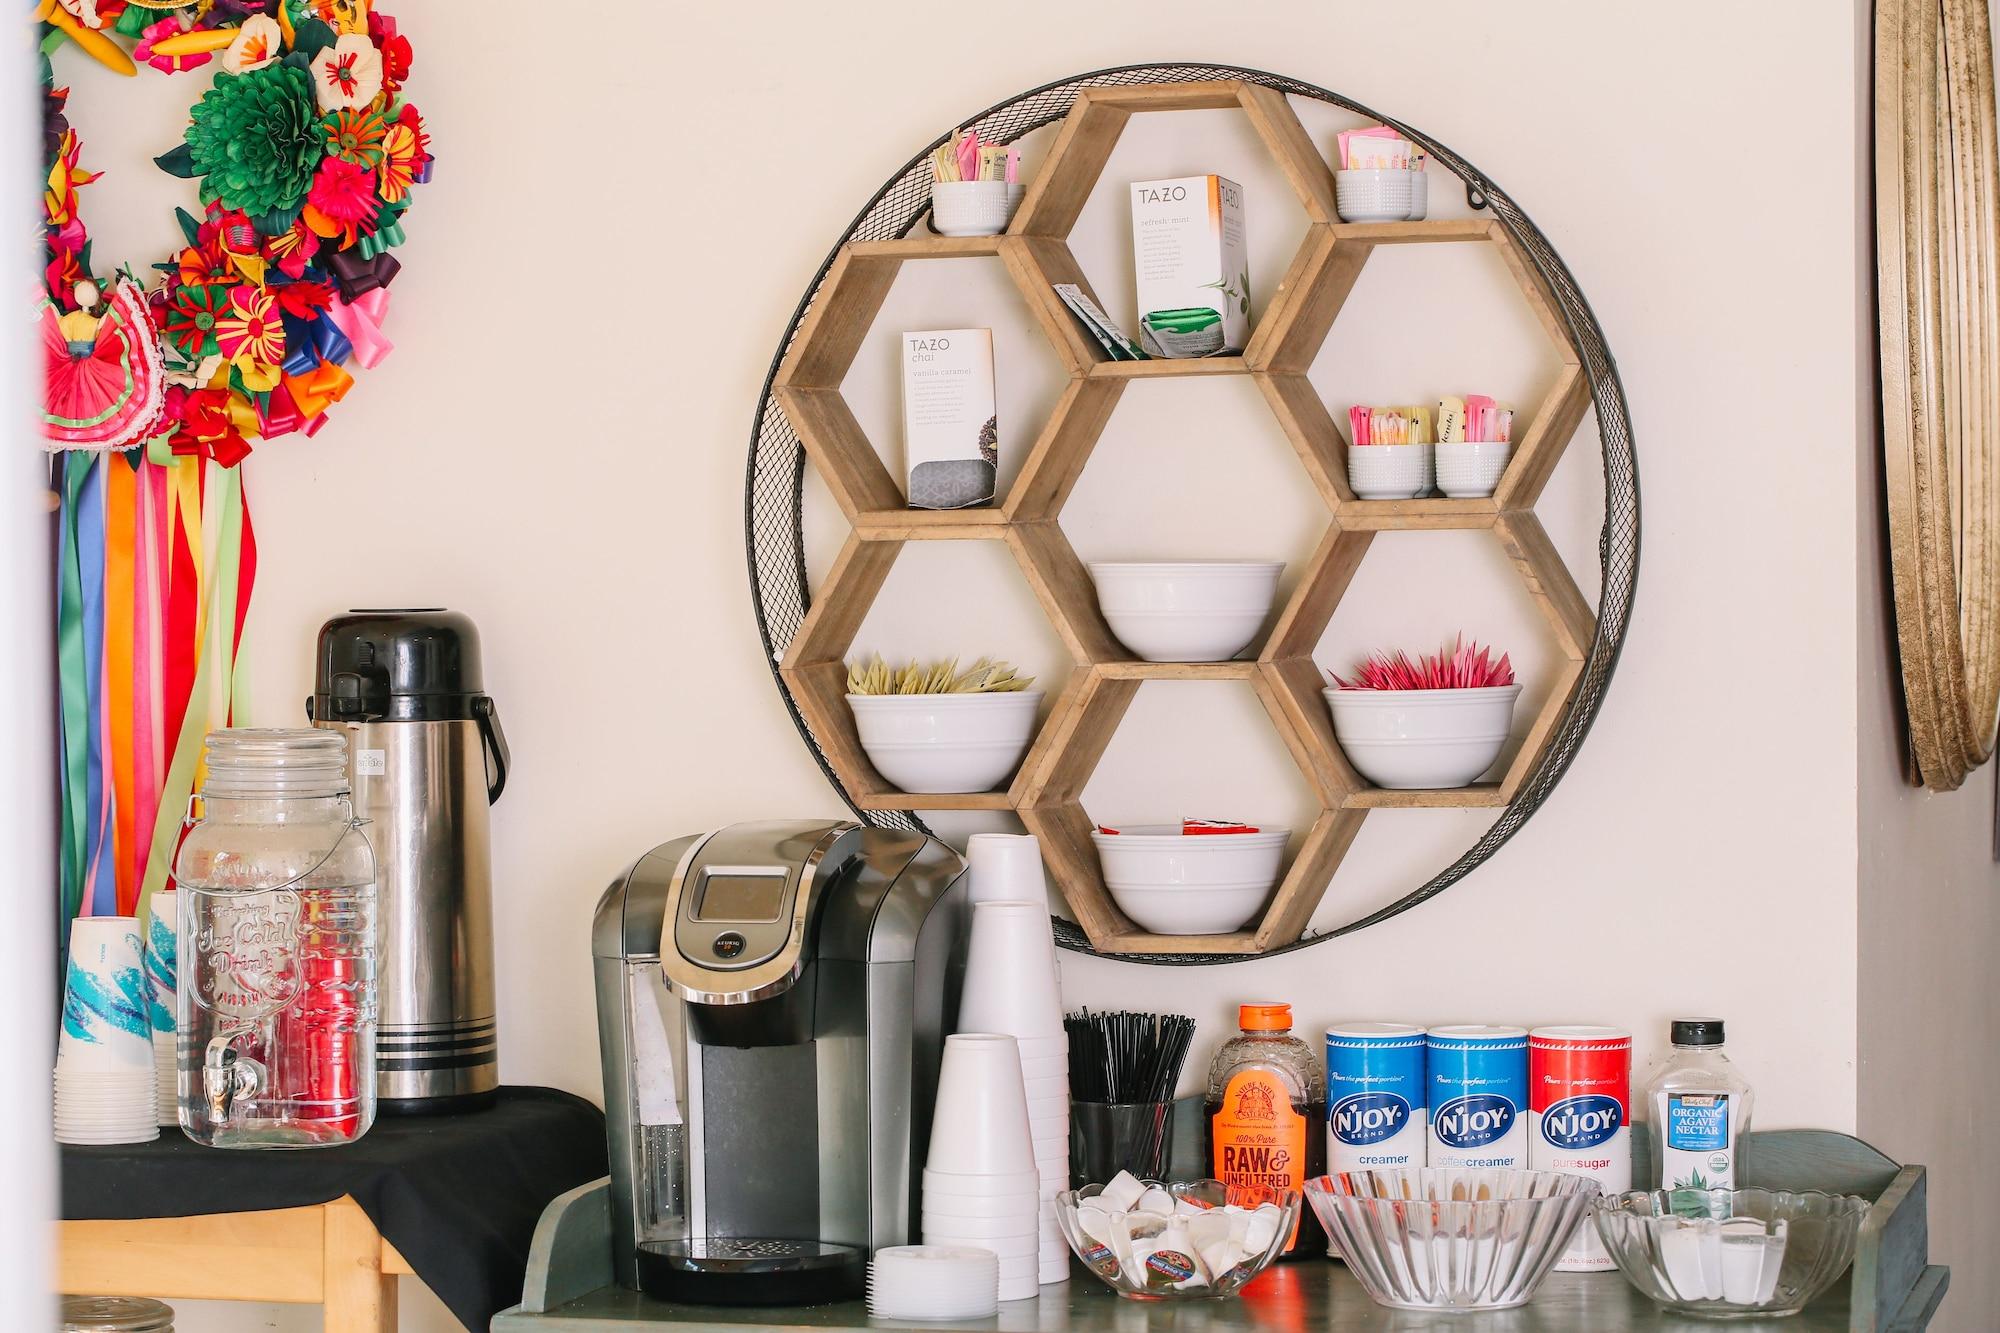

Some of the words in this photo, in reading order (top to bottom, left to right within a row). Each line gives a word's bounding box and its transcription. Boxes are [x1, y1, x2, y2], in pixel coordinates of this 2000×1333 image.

[1139, 186, 1187, 204] TAZO
[1221, 184, 1240, 209] TAZO
[909, 338, 950, 352] TAZO
[912, 352, 934, 363] chai
[912, 368, 939, 377] vanilla
[940, 367, 971, 376] caramel
[1441, 413, 1453, 443] lenda
[241, 922, 287, 945] Cold
[1461, 1077, 1487, 1086] perfect
[1571, 1077, 1597, 1087] perfect
[1672, 1107, 1723, 1118] ORGANIC
[1679, 1117, 1716, 1127] AGAVE
[1351, 1130, 1384, 1139] BRAND
[1675, 1125, 1719, 1135] NECTAR
[1256, 1133, 1277, 1144] Pure
[1457, 1133, 1491, 1142] BRAND
[1566, 1133, 1601, 1143] BRAND
[1224, 1146, 1270, 1173] RAW
[1269, 1149, 1290, 1172] &
